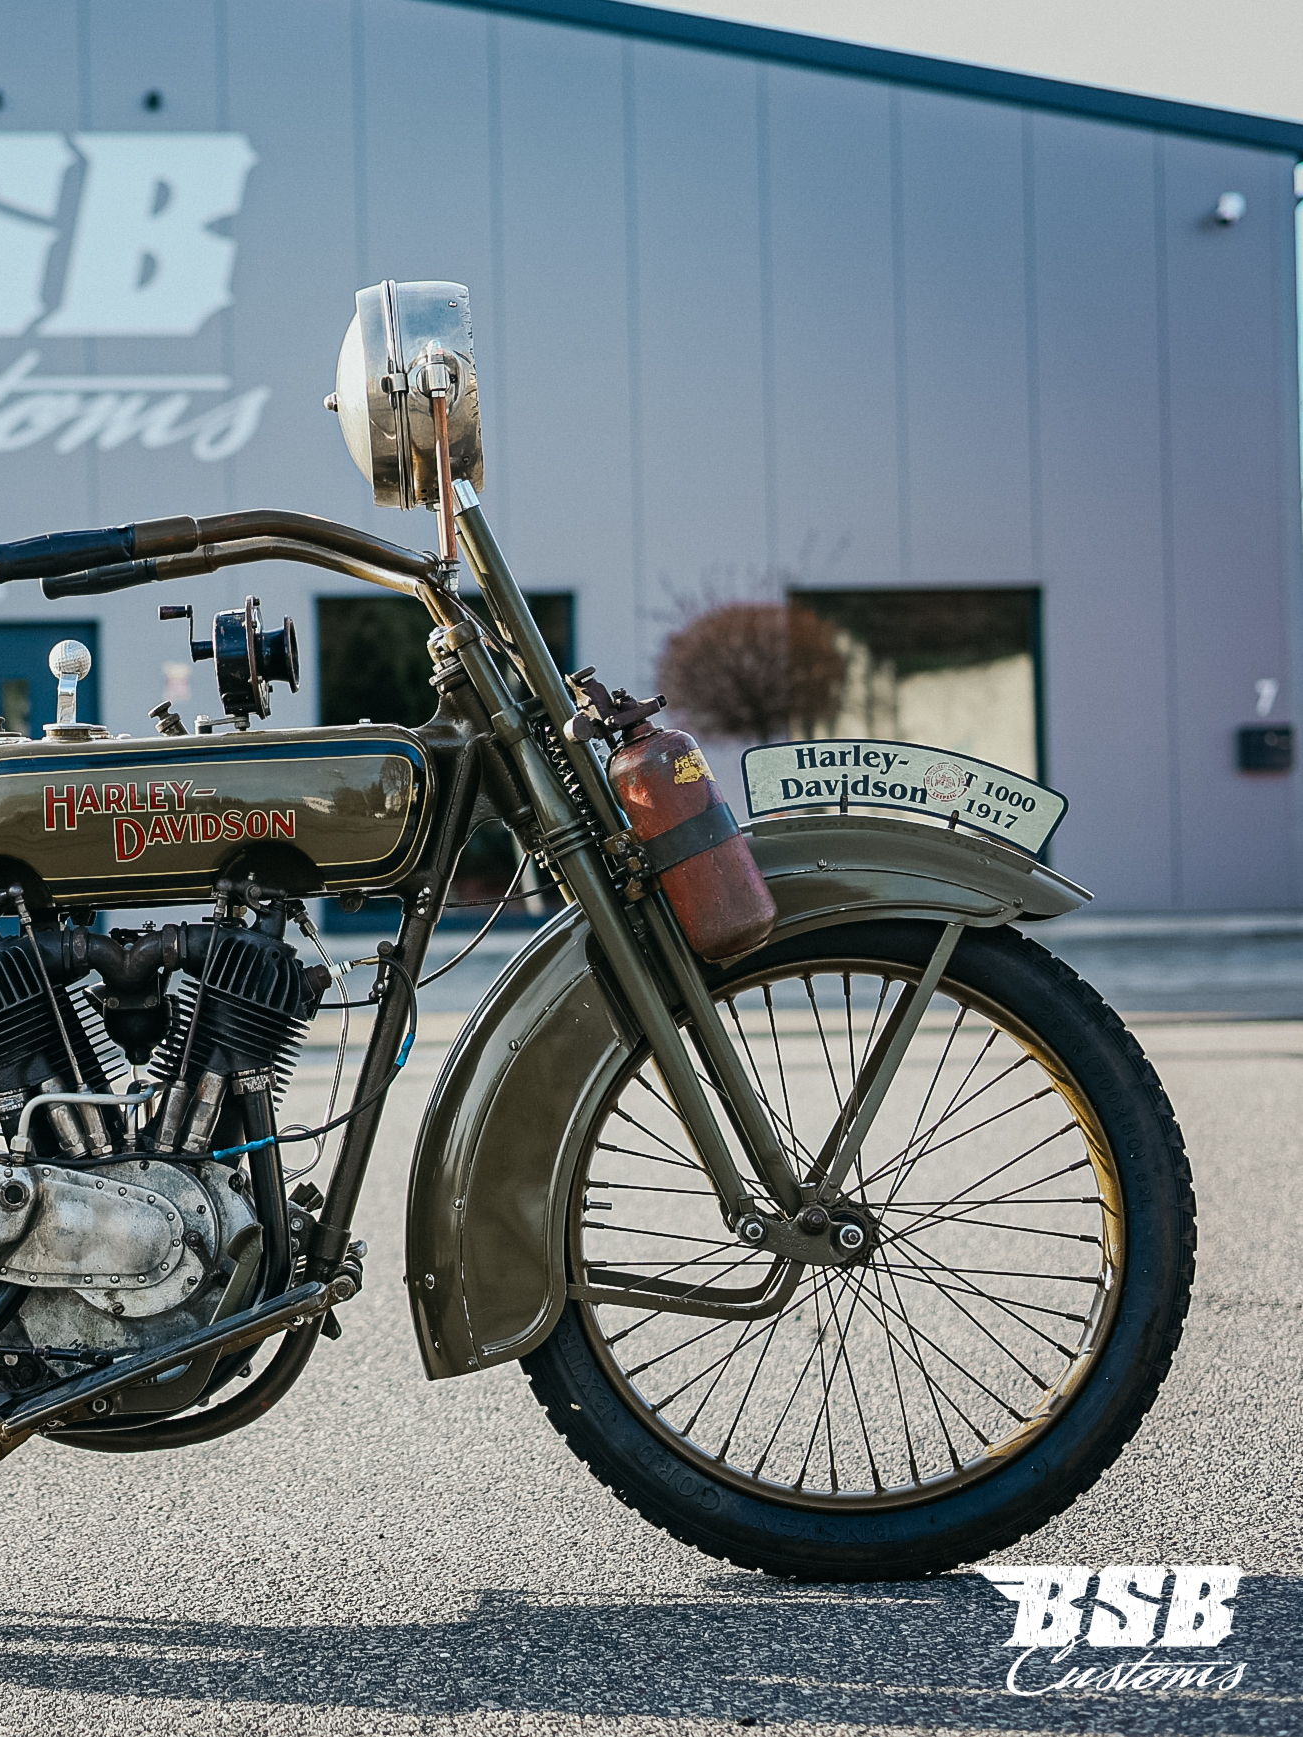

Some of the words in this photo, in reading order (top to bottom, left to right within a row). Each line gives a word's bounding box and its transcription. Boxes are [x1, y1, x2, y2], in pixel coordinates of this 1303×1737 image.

[794, 745, 910, 775] Harley-
[44, 780, 217, 831] HARLEY-
[780, 774, 928, 805] Davidson
[964, 771, 979, 788] T
[981, 780, 1037, 813] 1000
[963, 798, 1019, 831] 1917
[113, 809, 296, 863] DAVIDSON
